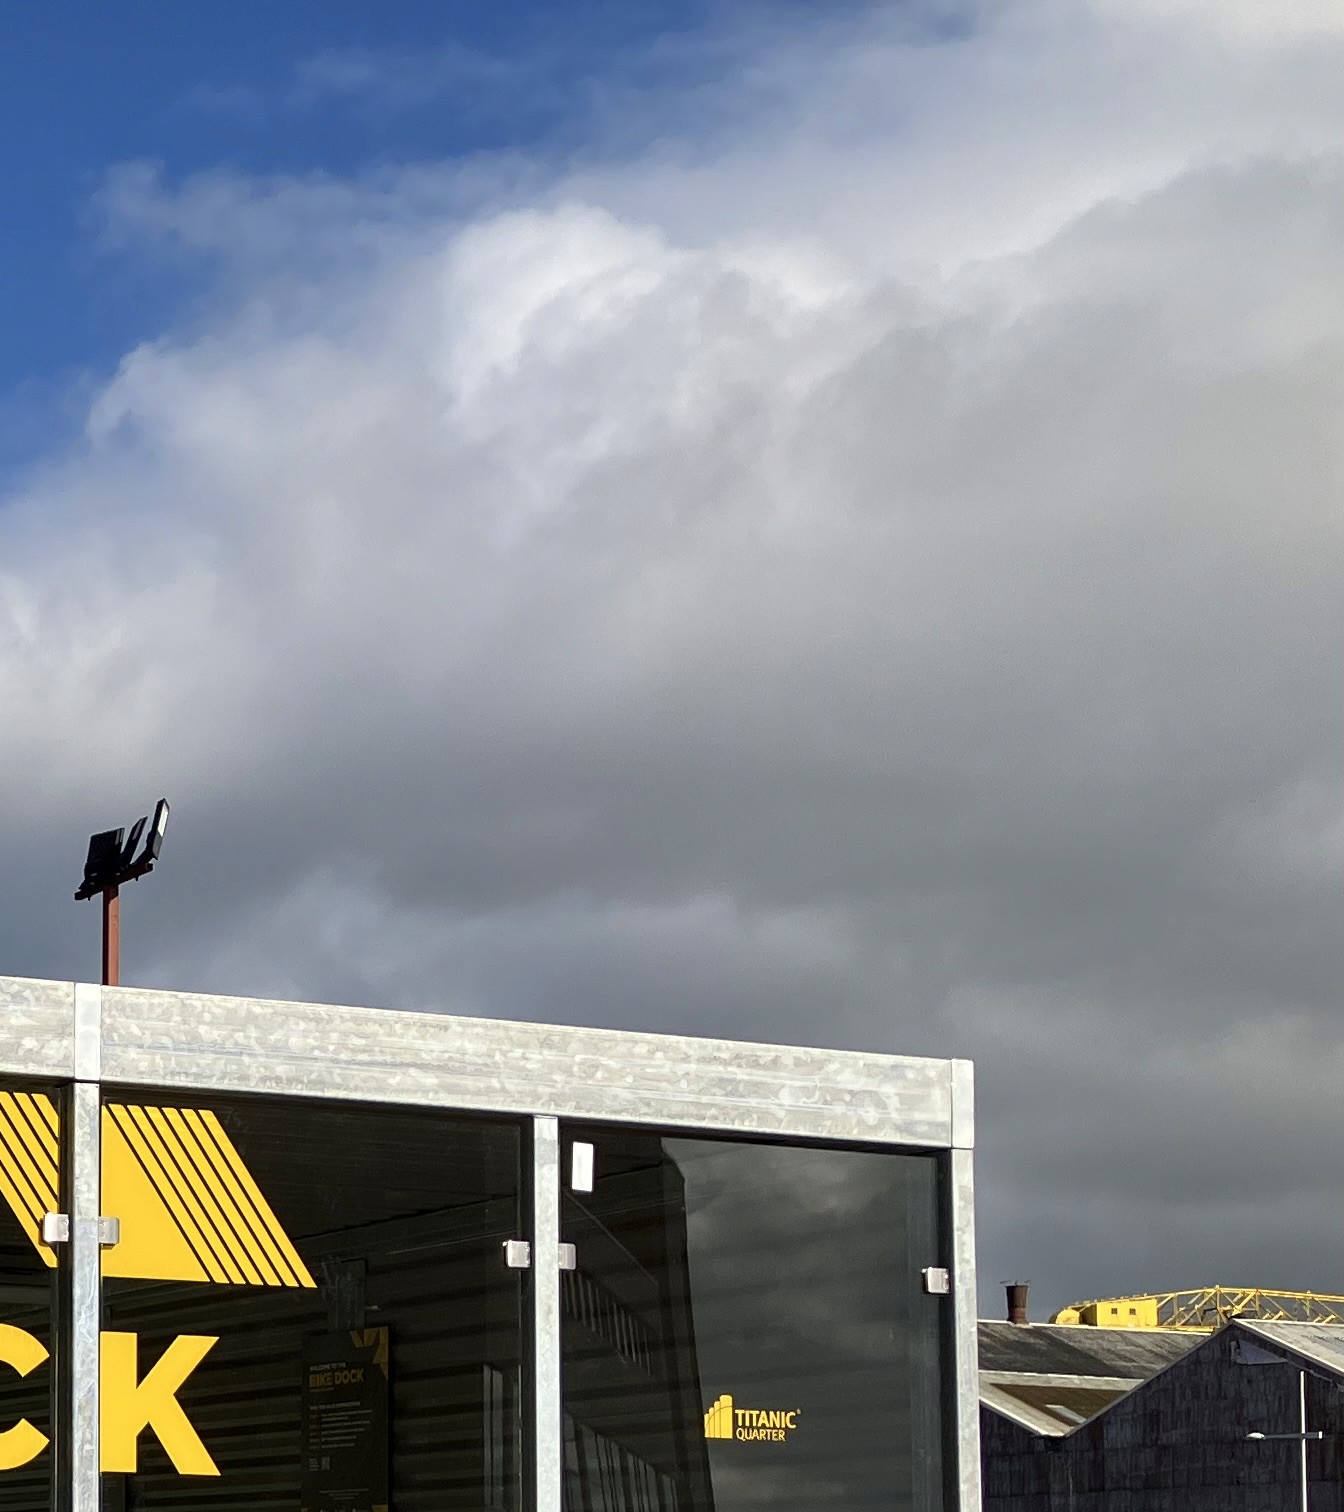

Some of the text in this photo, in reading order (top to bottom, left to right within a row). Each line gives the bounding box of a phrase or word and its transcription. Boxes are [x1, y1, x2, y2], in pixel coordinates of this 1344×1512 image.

[308, 1368, 364, 1387] BIKE DOCK
[735, 1409, 797, 1428] TITANIC
[736, 1428, 786, 1441] QUARTER
